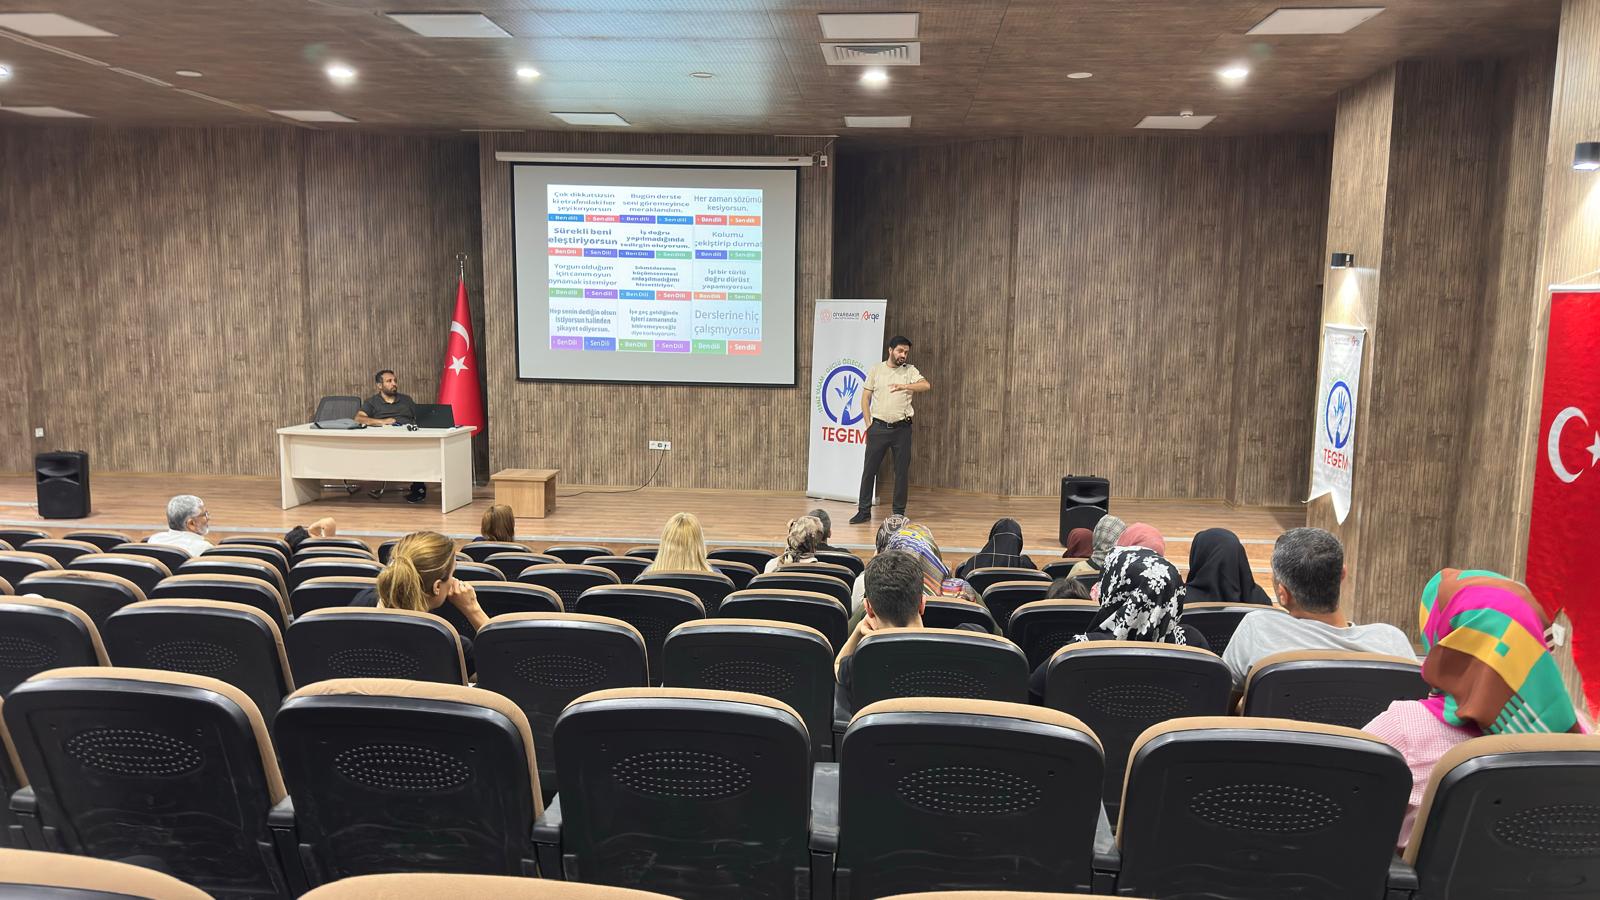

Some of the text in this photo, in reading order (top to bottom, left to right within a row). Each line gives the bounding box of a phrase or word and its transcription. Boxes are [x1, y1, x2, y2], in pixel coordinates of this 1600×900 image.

[708, 204, 749, 212] kesiyorsun.
[695, 310, 759, 324] Derslerine hiç
[694, 324, 760, 336] çalışmıyorsun
[822, 426, 868, 444] TEGEM
[1323, 448, 1349, 472] TEGEM
